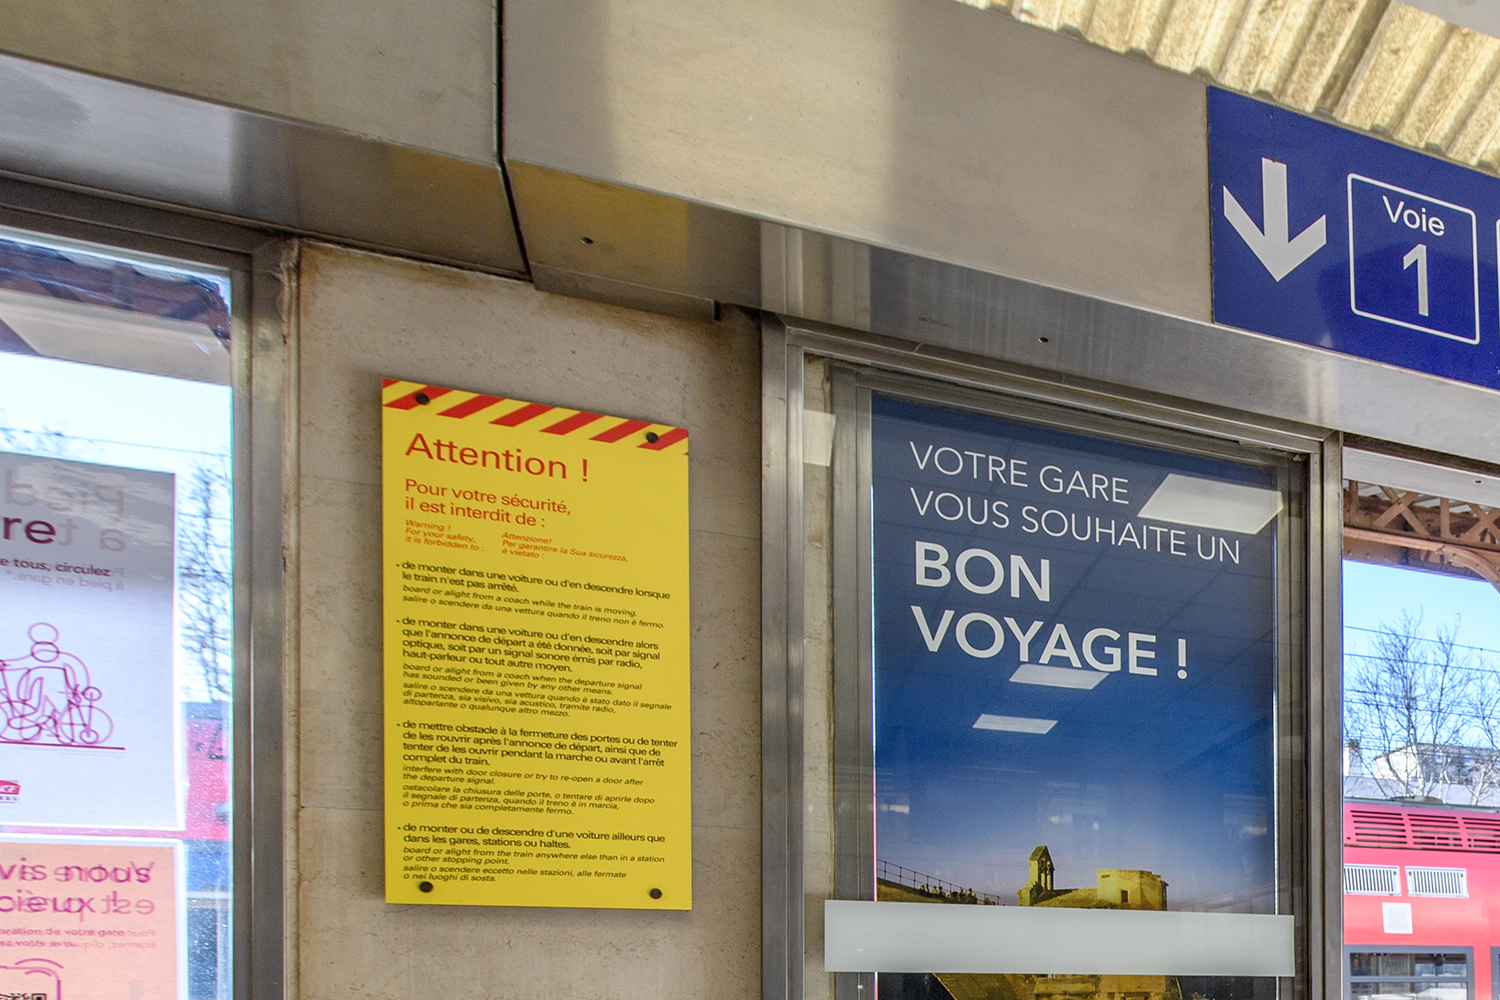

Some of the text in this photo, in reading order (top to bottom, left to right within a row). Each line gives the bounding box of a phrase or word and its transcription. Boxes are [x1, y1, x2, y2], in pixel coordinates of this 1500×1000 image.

[1382, 195, 1445, 238] Voie
[1402, 243, 1430, 318] 1
[405, 431, 587, 482] Attention !
[909, 440, 1129, 505] VOTRE GARE
[406, 478, 570, 515] Pour votre sécurité,
[406, 496, 544, 527] il est interdit de :
[910, 486, 1240, 565] VOUS SOUHAITE UN
[13, 557, 111, 577] tous, circulez
[401, 560, 415, 570] de
[418, 563, 456, 574] monter
[458, 567, 484, 578] dans
[486, 572, 506, 580] une
[507, 572, 543, 584] voiture
[560, 579, 581, 589] d'en
[583, 582, 633, 595] descendre
[635, 588, 670, 600] lorsque
[402, 571, 518, 592] le train n'est pas arrêté.
[915, 540, 1051, 603] BON
[402, 584, 431, 593] board
[443, 589, 470, 599] alight
[471, 592, 494, 600] from
[503, 596, 530, 604] coach
[531, 599, 556, 607] while
[557, 601, 572, 609] the
[572, 603, 593, 611] train
[603, 606, 637, 617] moving.
[402, 616, 658, 650] de monter dans une voiture ou d'en descendre alors
[402, 628, 423, 638] que
[425, 629, 476, 642] l'annonce
[478, 634, 491, 643] de
[493, 636, 526, 648] départ
[536, 640, 551, 649] été
[553, 642, 593, 654] donnée,
[595, 646, 612, 655] soit
[615, 649, 630, 658] par
[632, 649, 660, 661] signal
[910, 604, 1188, 680] VOYAGE !
[402, 637, 642, 669] optique, soit par un signal sonore émis par radio,
